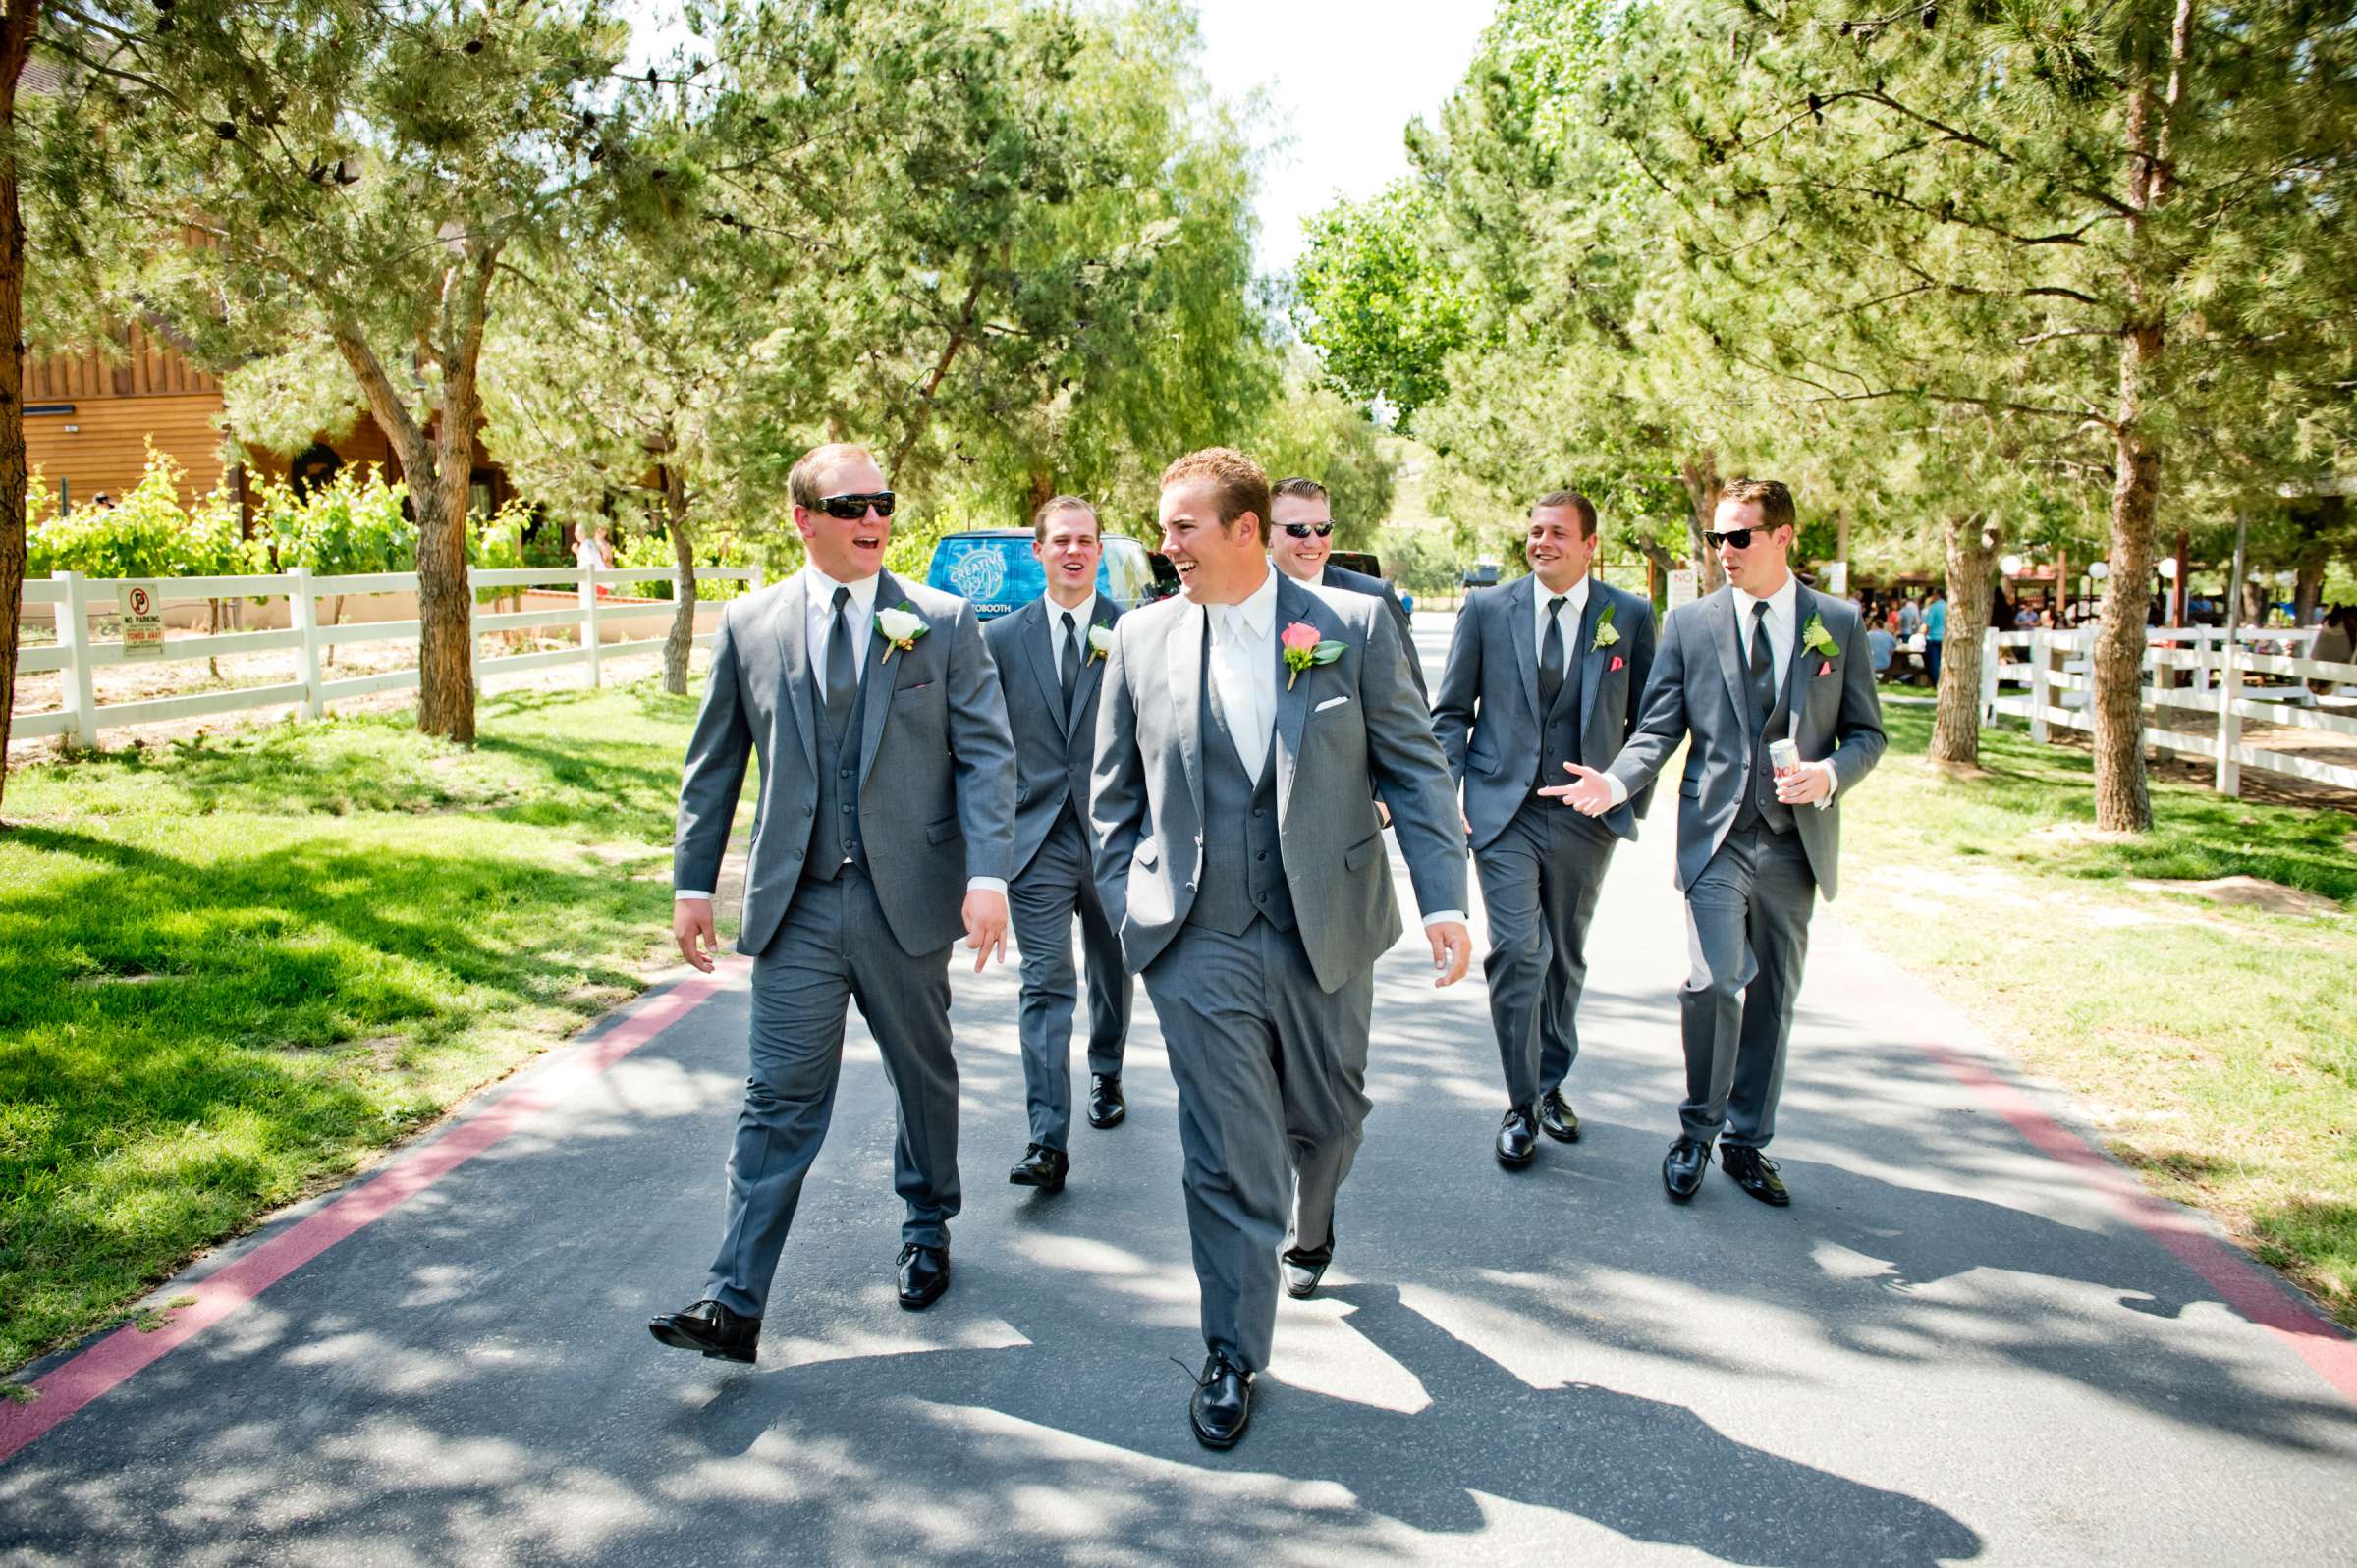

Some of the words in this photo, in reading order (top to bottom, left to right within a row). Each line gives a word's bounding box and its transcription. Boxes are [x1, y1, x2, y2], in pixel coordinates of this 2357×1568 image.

[950, 550, 1004, 583] CREATIVE
[1673, 572, 1693, 582] NO
[973, 604, 1012, 613] OBOOTH
